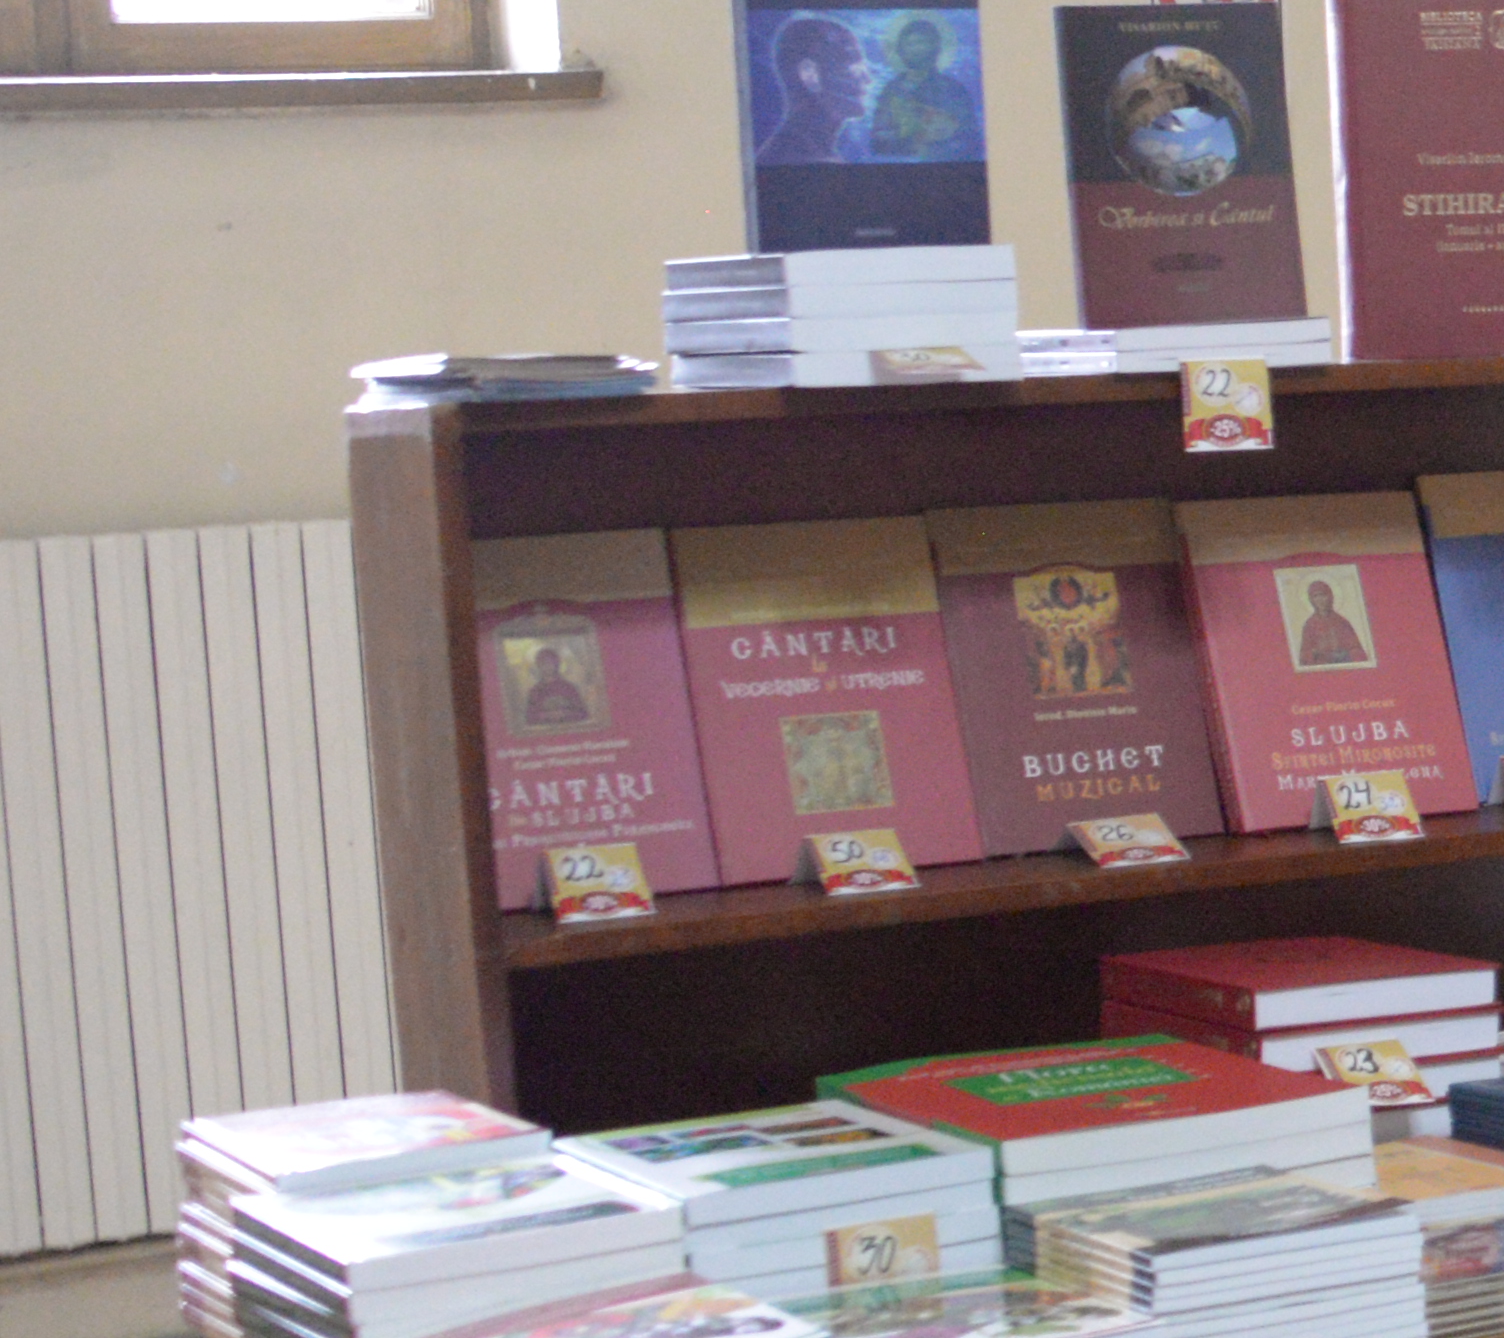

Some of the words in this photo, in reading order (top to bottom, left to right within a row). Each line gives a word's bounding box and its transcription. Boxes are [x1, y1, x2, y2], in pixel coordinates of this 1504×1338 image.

[1199, 367, 1233, 398] 22
[1290, 719, 1410, 748] SLUJBA
[1021, 744, 1165, 779] BUCHET
[1035, 773, 1162, 803] MUZICAL
[1338, 780, 1372, 811] 24
[1098, 823, 1135, 843] 26
[561, 854, 604, 882] 22
[857, 1235, 898, 1275] 30
